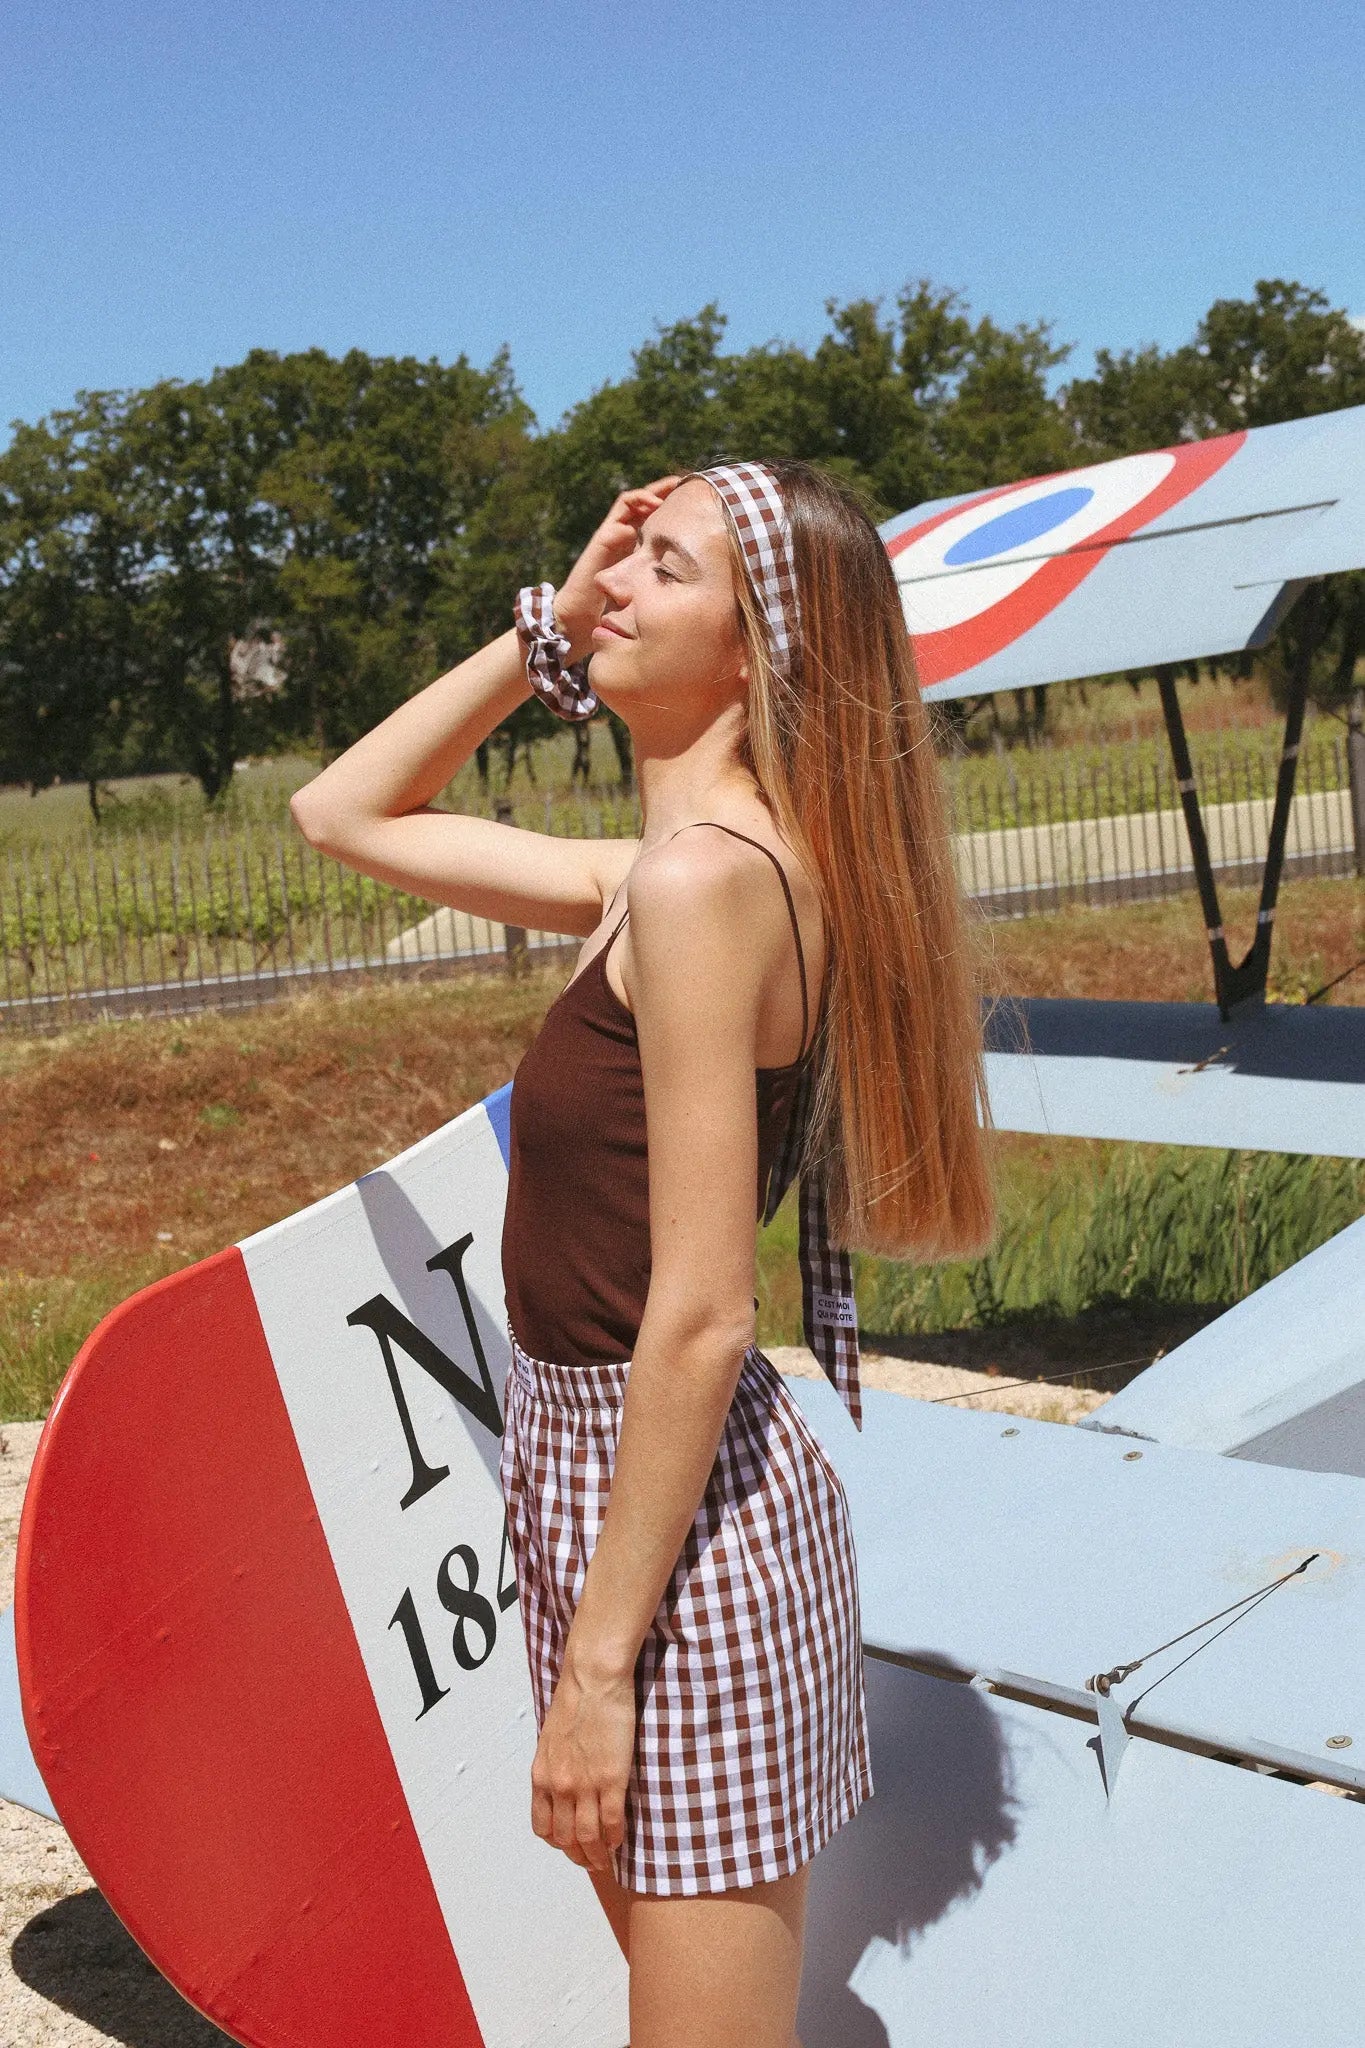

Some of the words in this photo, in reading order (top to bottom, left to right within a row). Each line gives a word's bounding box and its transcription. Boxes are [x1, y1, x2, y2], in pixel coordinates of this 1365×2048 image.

[818, 1299, 835, 1309] C'EST
[836, 1301, 850, 1310] MOI
[817, 1310, 829, 1319] QUI
[830, 1312, 853, 1321] PILOTE
[346, 1232, 504, 1511] N
